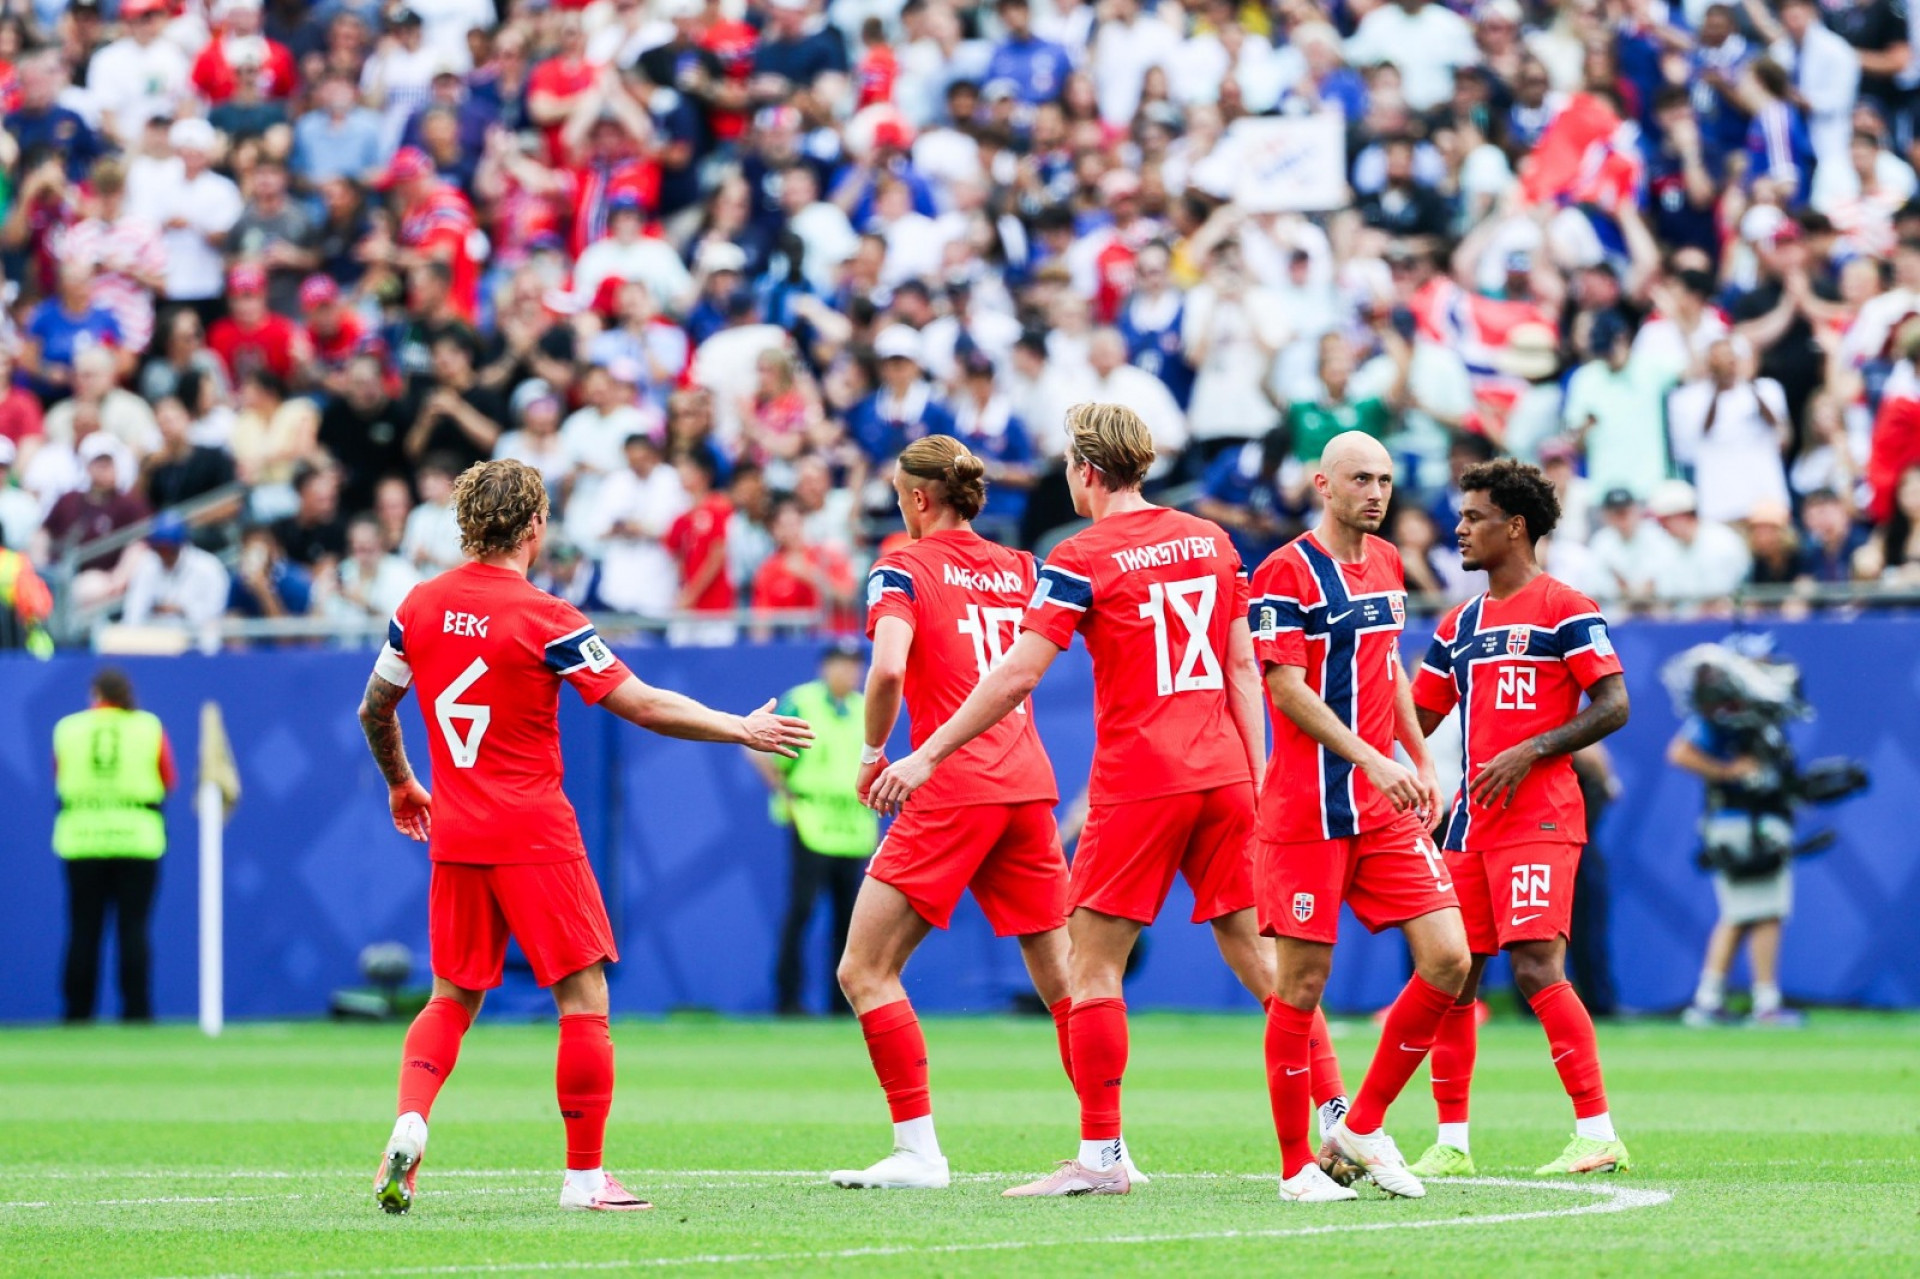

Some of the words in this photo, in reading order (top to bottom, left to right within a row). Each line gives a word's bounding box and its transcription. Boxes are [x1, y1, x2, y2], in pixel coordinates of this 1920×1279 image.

[1111, 536, 1217, 573] THORSTVEDT
[943, 563, 1023, 594] AASGAARD
[443, 610, 490, 639] BERG
[1138, 574, 1224, 697] 18
[1495, 666, 1537, 710] 22
[435, 655, 490, 769] 6
[1511, 864, 1551, 909] 22
